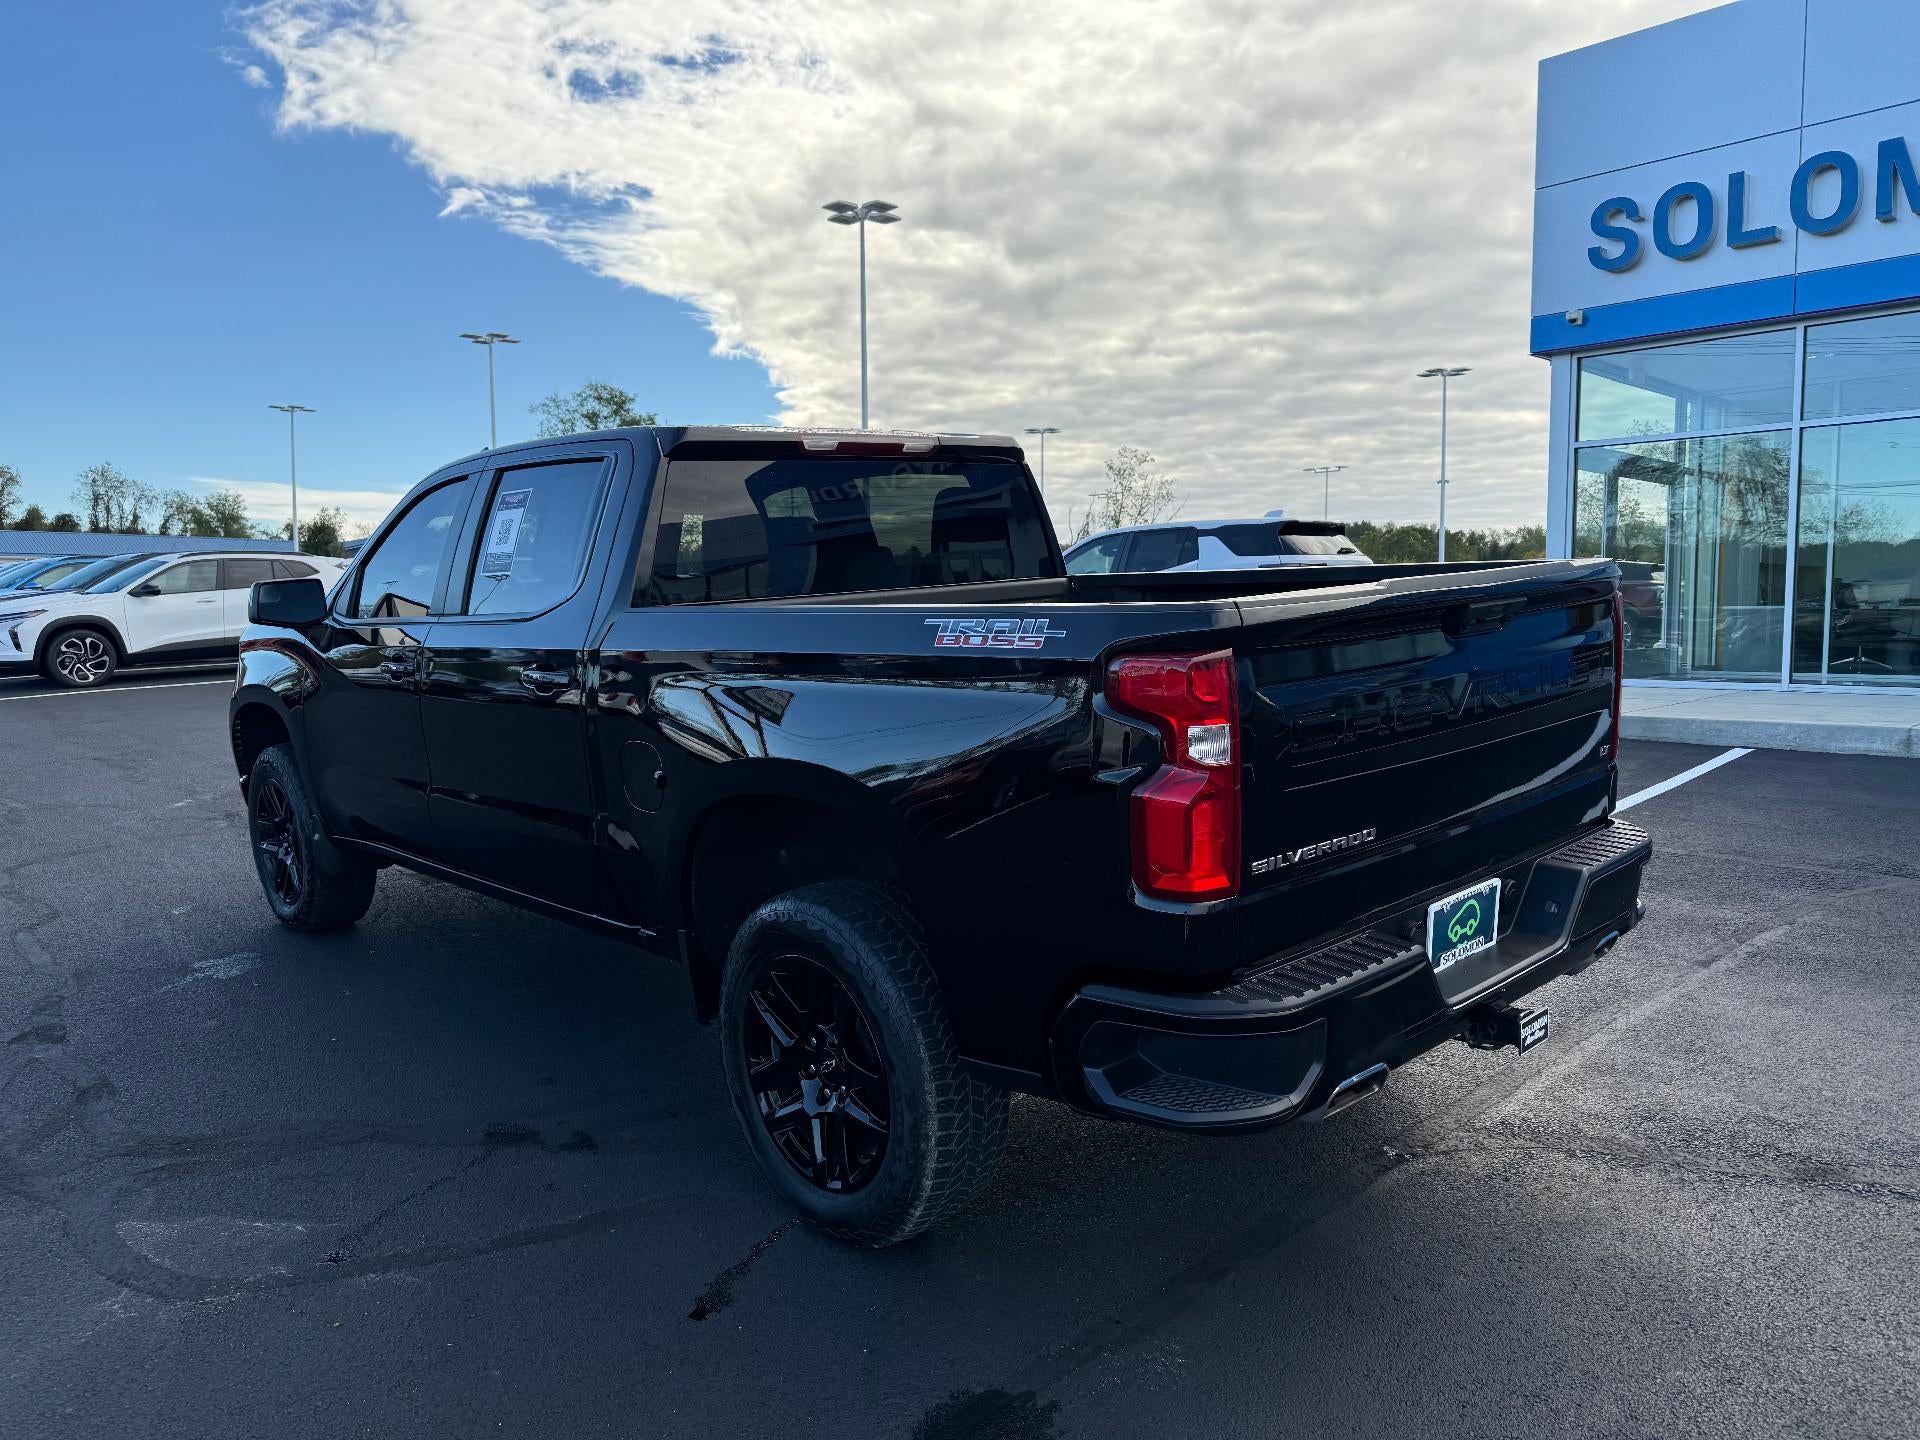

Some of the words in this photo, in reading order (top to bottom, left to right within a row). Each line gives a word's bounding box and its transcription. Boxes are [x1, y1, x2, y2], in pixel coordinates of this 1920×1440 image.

[924, 619, 1066, 637] TRAIL
[934, 634, 1045, 649] BOSS
[1251, 828, 1376, 875] SILVERADO
[1442, 936, 1485, 965] SOLOMON
